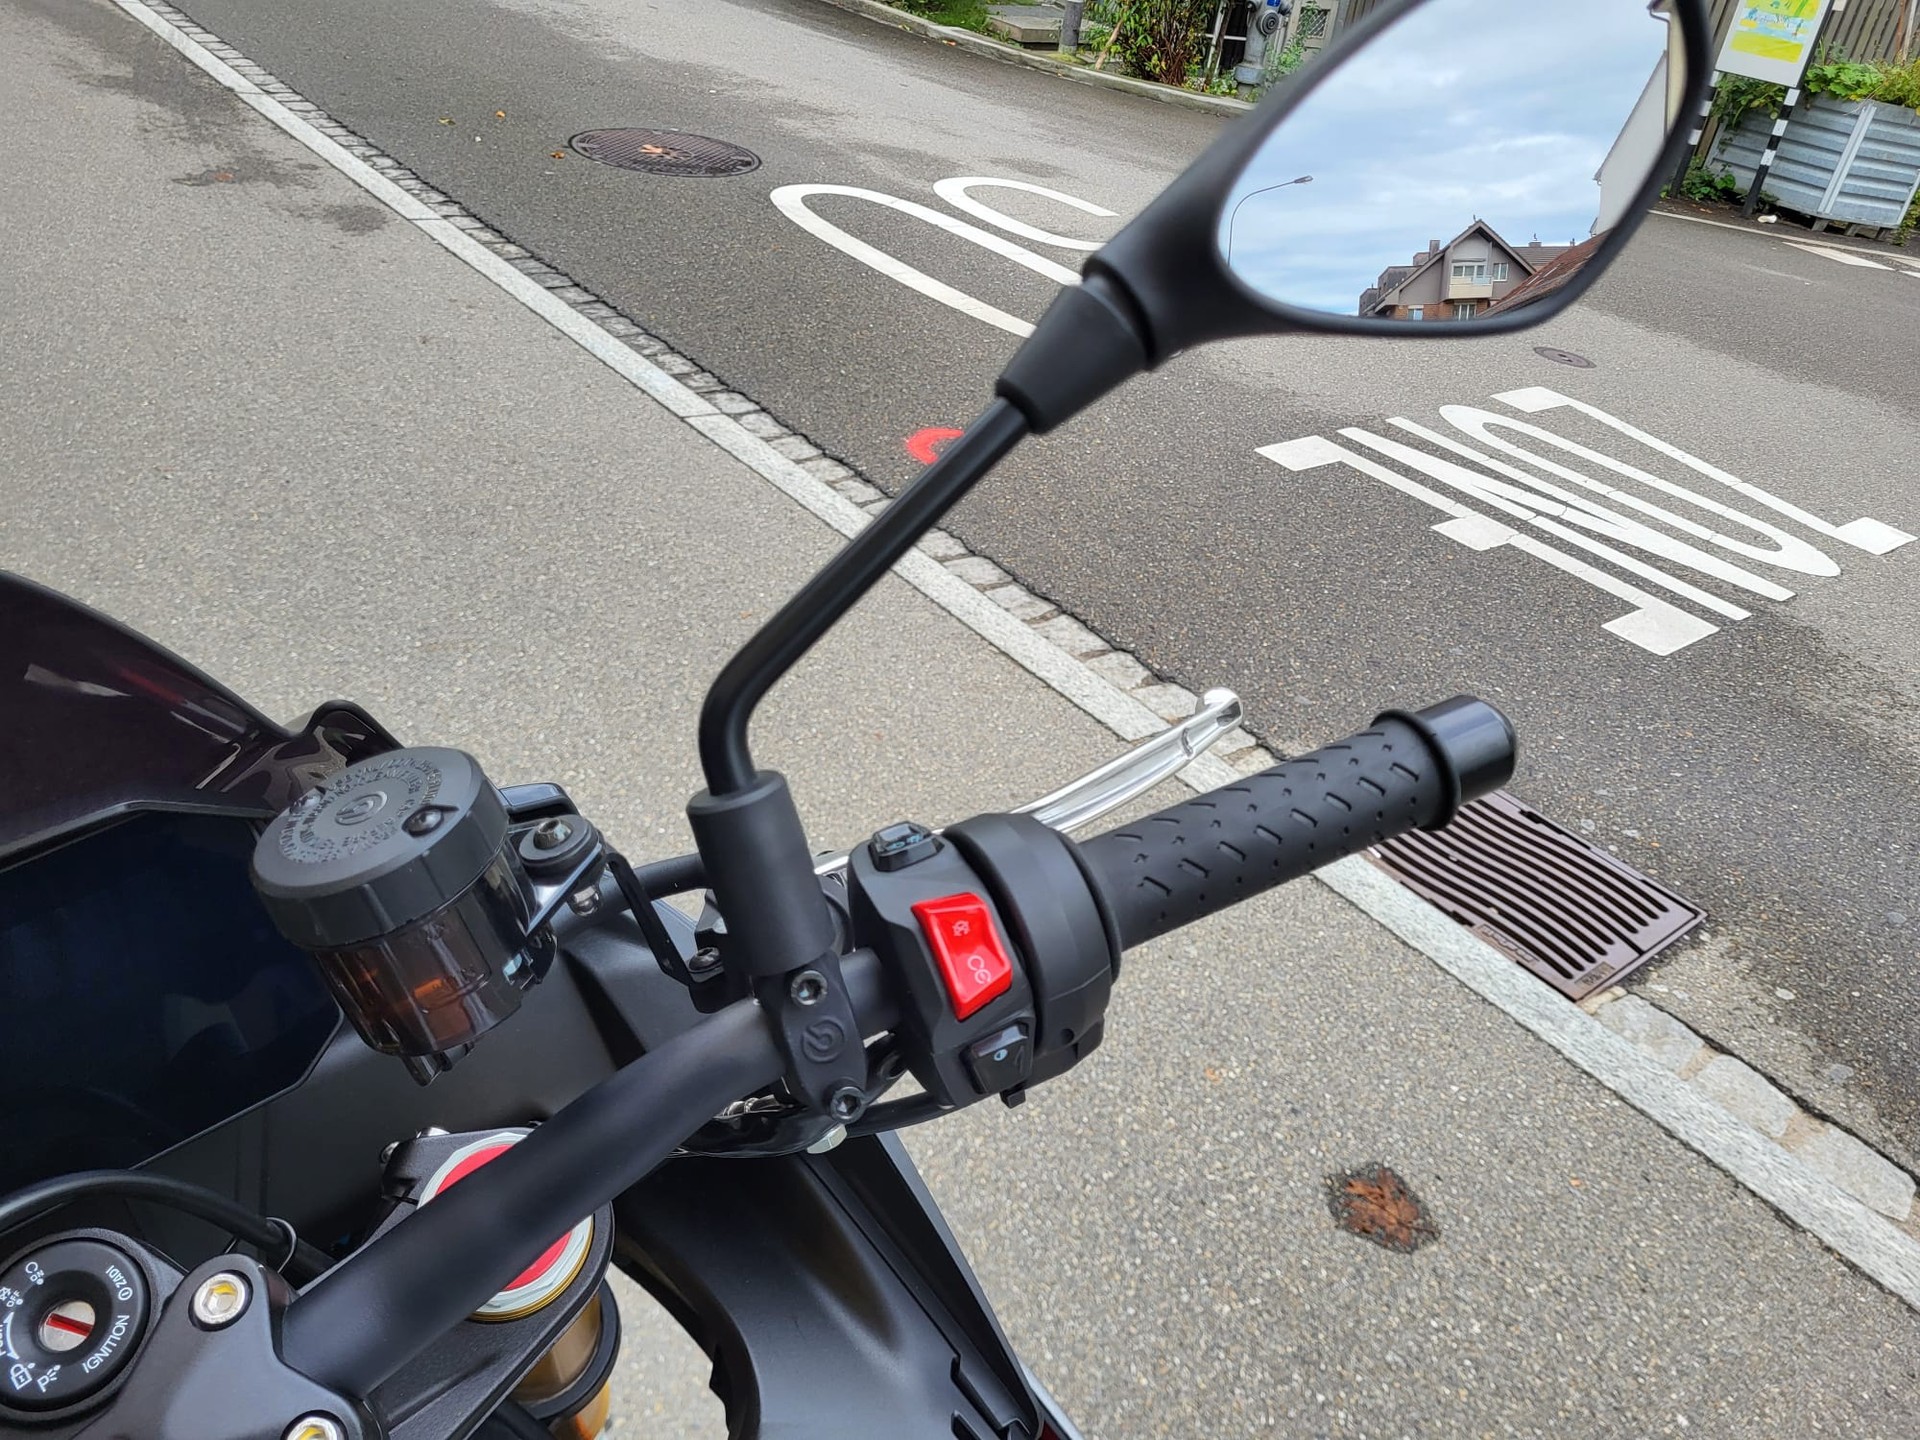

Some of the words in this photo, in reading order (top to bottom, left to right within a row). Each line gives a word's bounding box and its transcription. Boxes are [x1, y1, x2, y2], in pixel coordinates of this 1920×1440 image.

[1254, 386, 1918, 656] ZONE
[105, 1265, 127, 1288] ZADI
[6, 1290, 21, 1308] OFF
[81, 1314, 131, 1374] IGNITION
